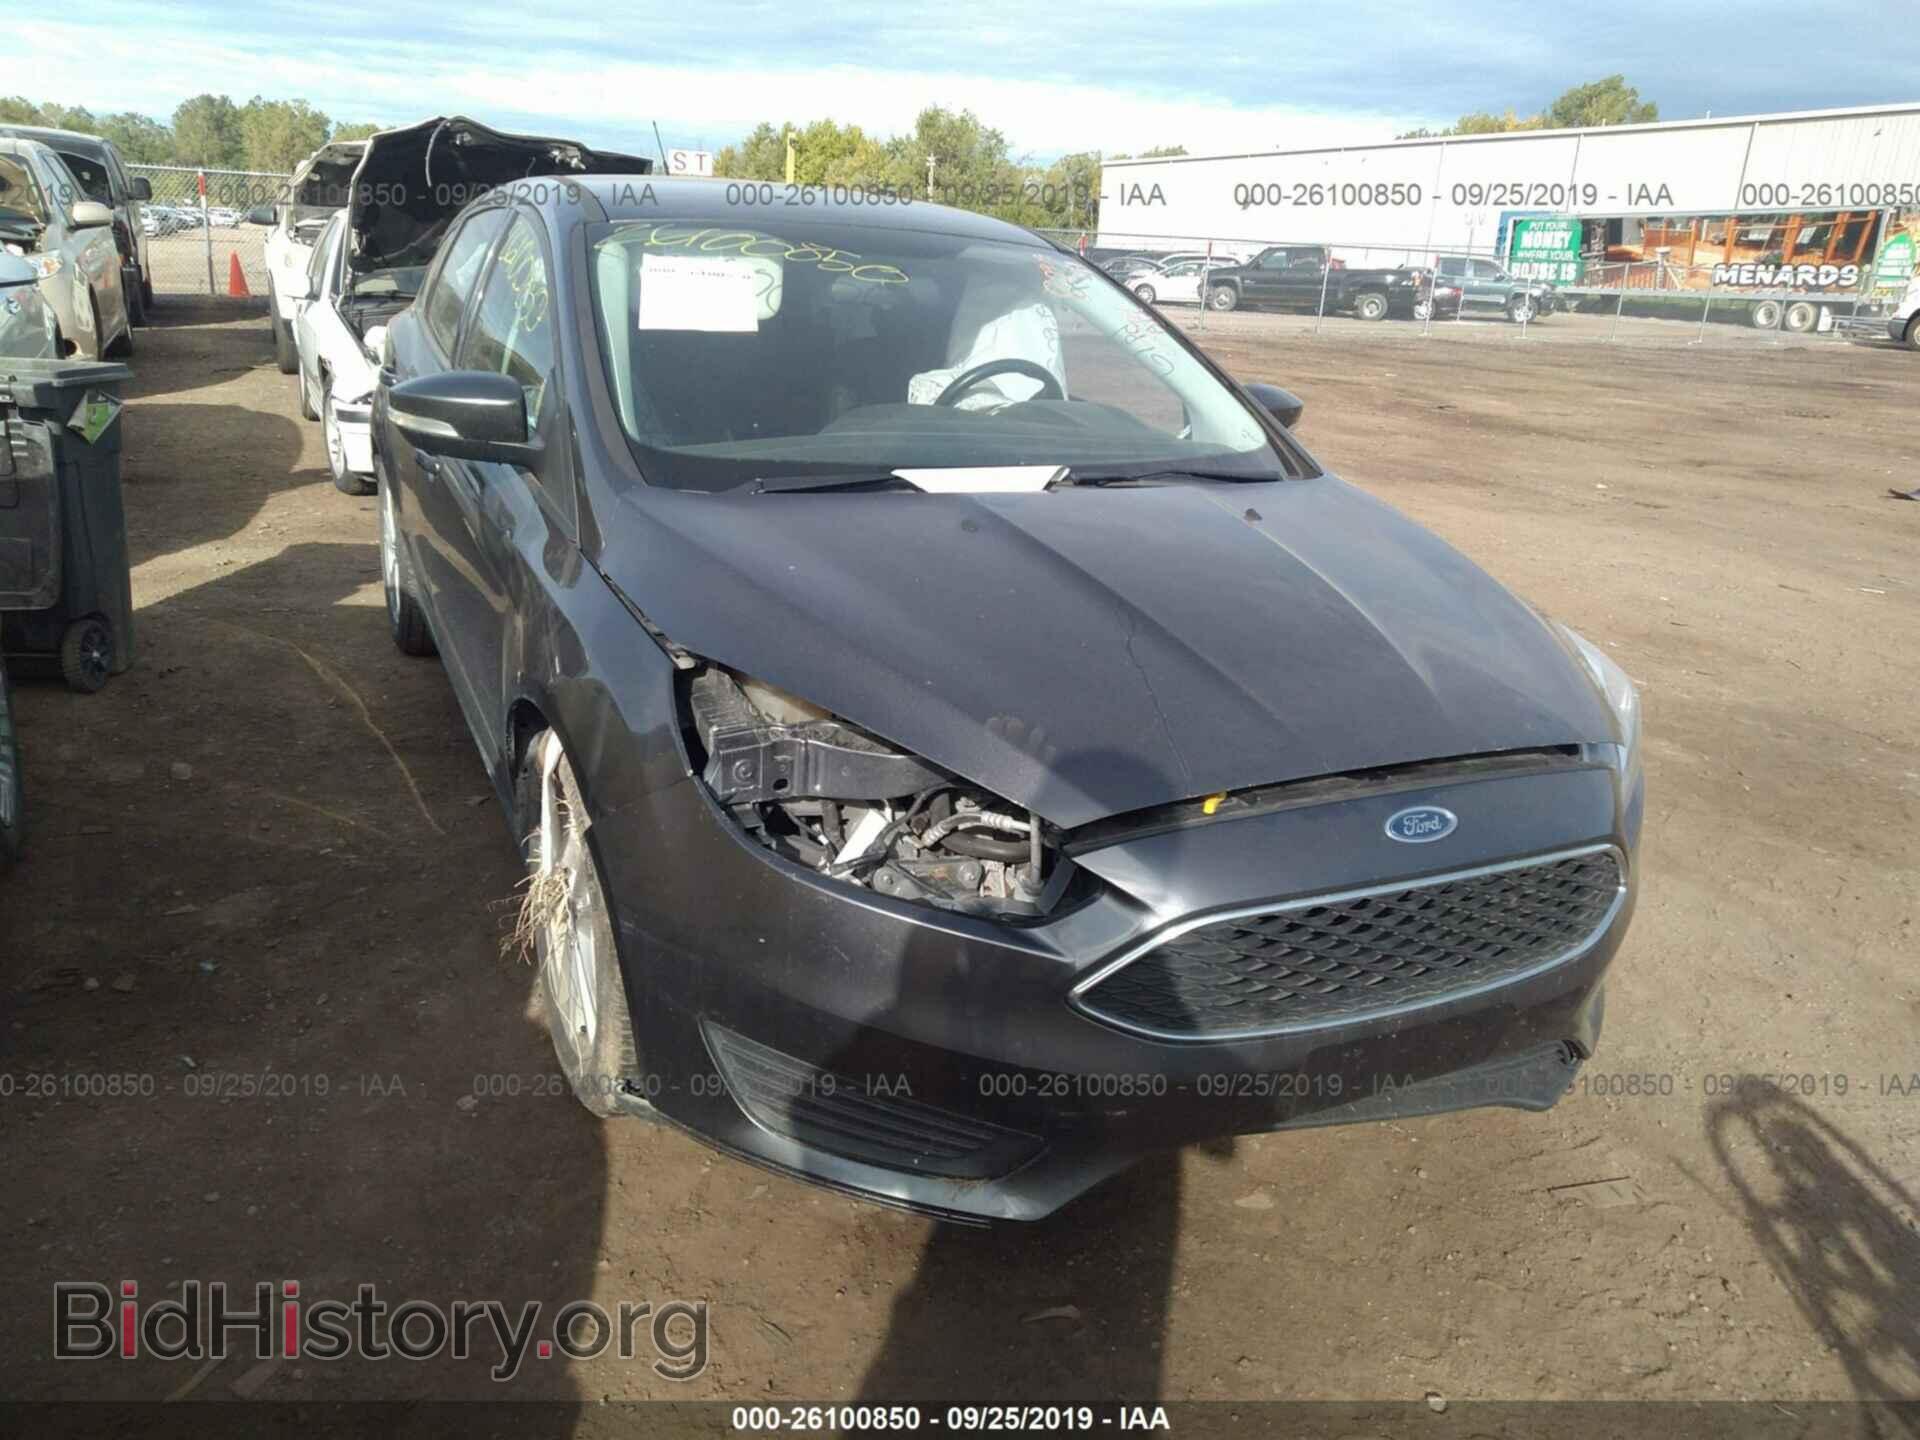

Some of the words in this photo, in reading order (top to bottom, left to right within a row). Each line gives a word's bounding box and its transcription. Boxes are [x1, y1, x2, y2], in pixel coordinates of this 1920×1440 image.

[1520, 231, 1572, 249] MONEY
[1713, 263, 1860, 287] MENARDS
[1403, 813, 1441, 835] Ford
